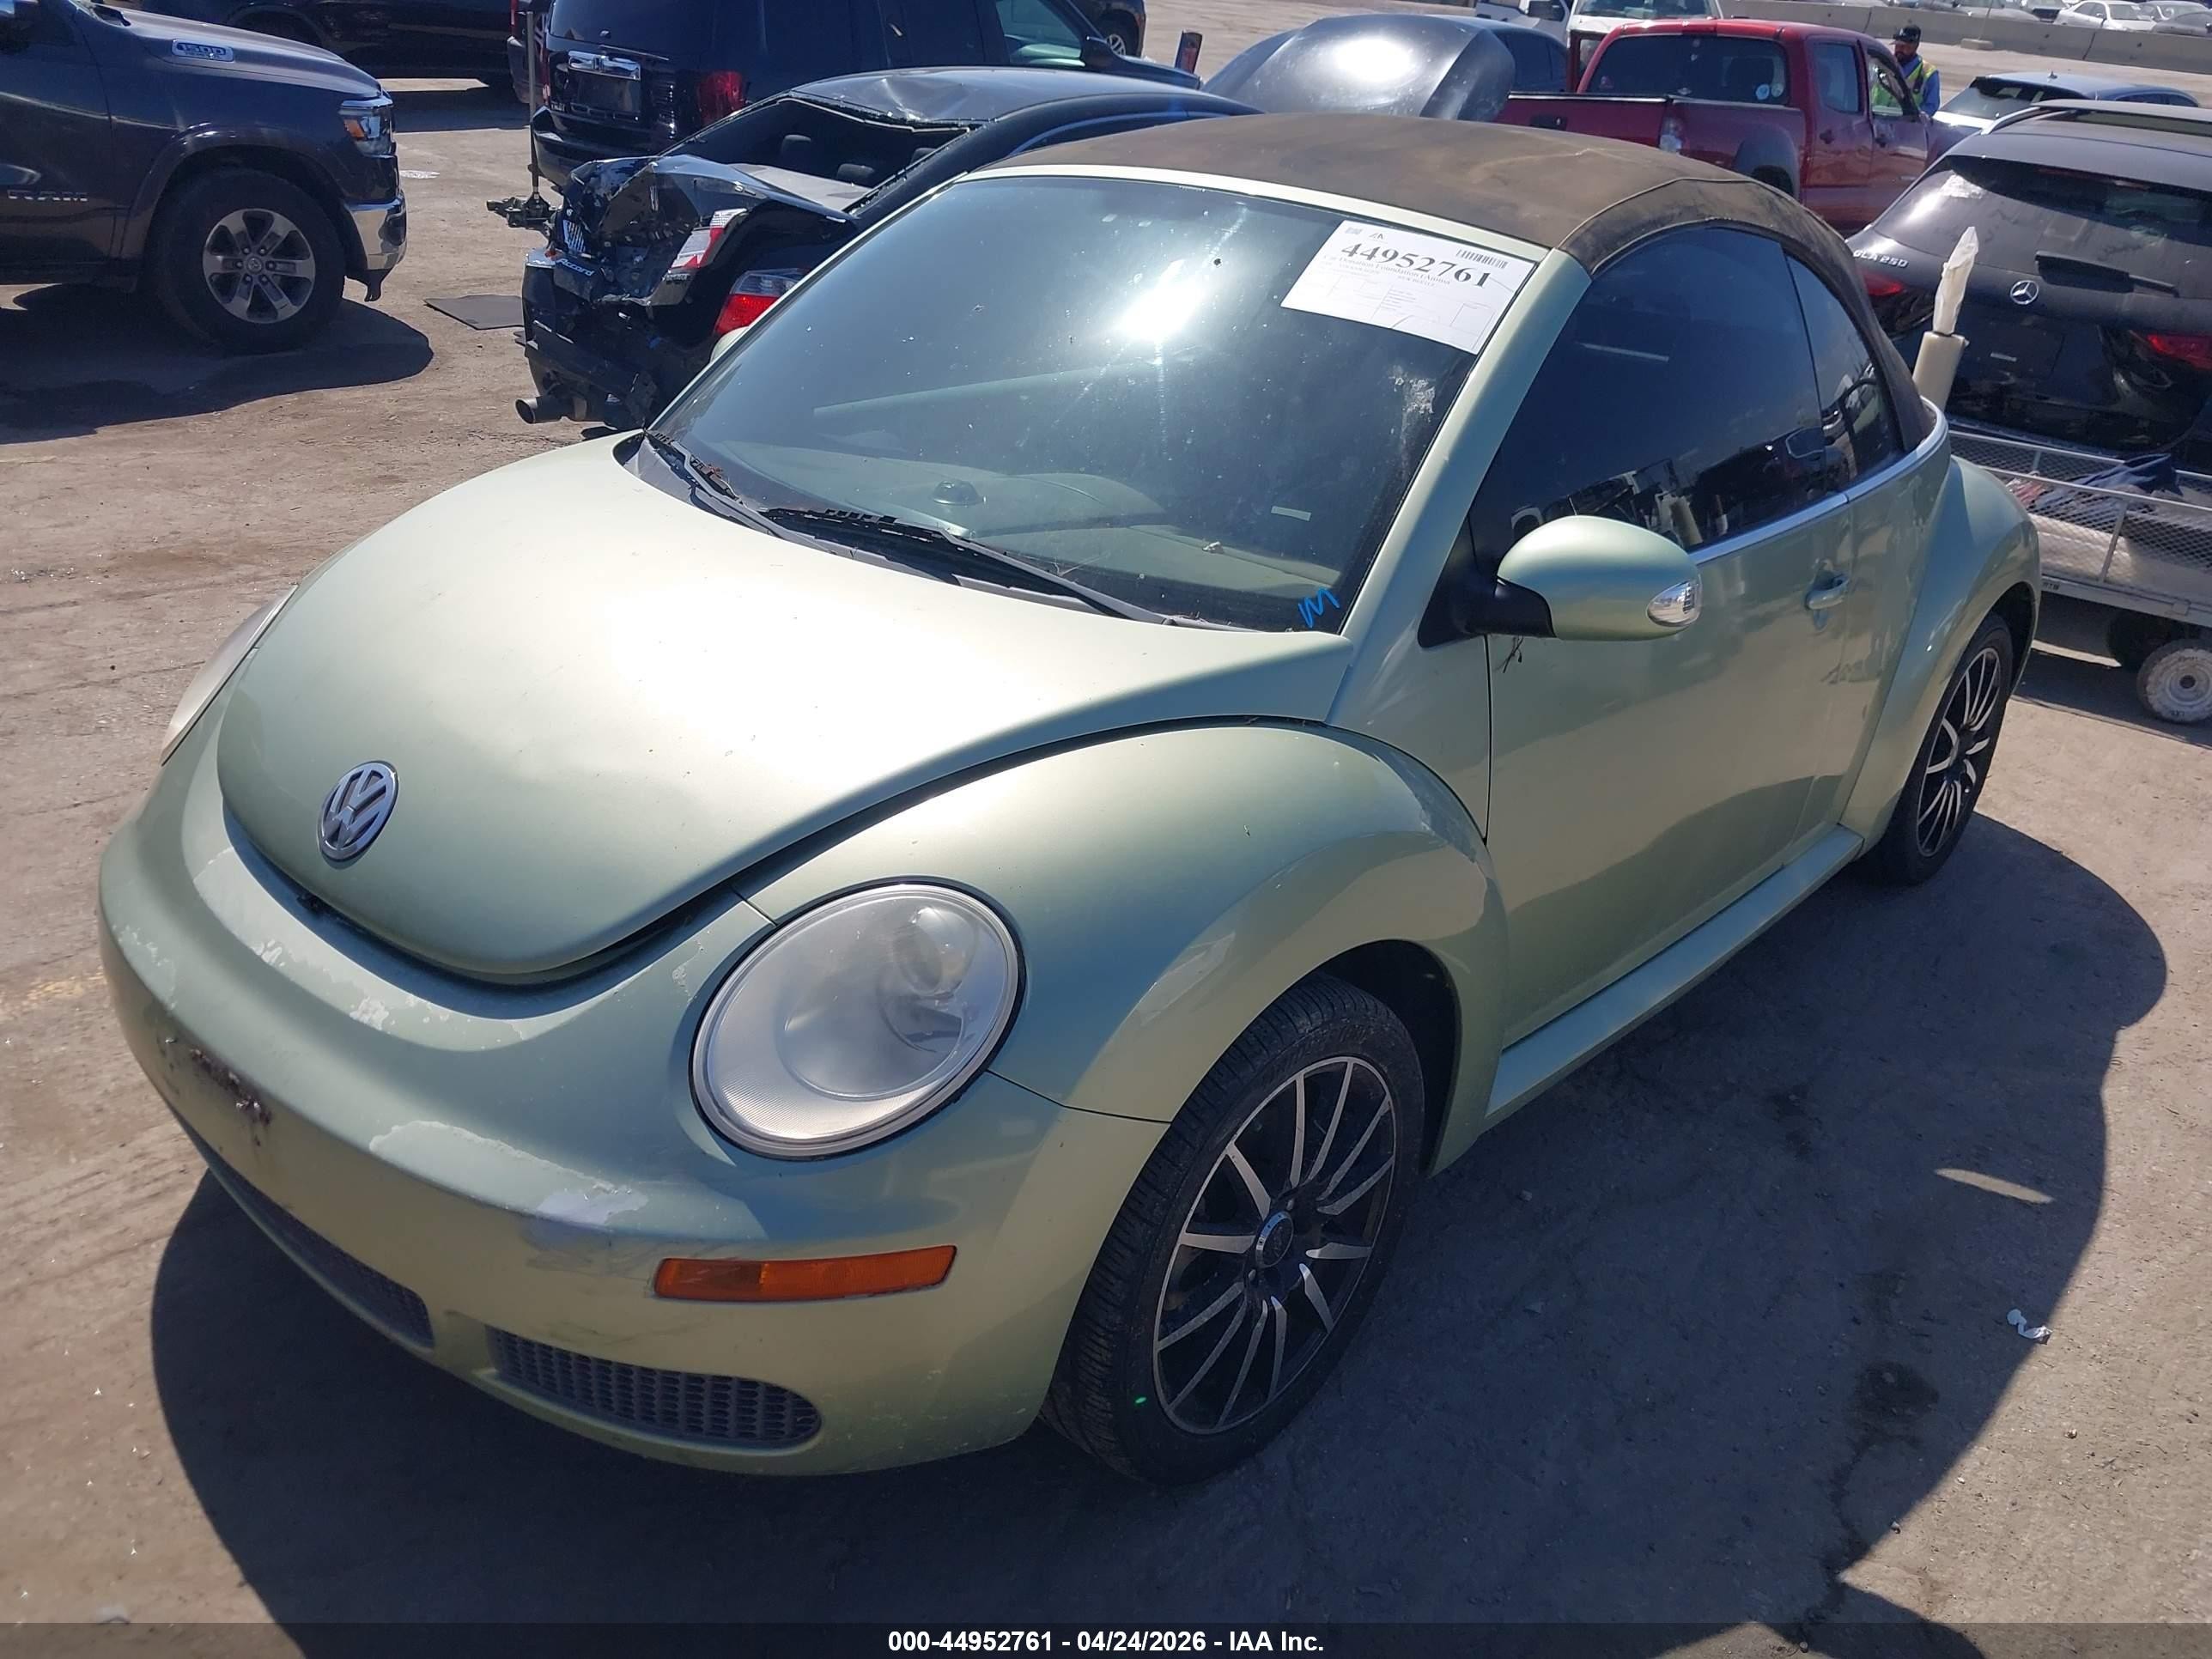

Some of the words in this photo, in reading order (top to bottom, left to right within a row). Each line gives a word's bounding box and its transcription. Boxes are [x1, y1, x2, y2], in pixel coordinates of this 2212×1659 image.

[177, 42, 227, 56] 1500
[556, 258, 595, 276] Accord
[1341, 242, 1492, 289] 44952761
[1852, 249, 1879, 261] GLA
[1879, 254, 1909, 268] 250
